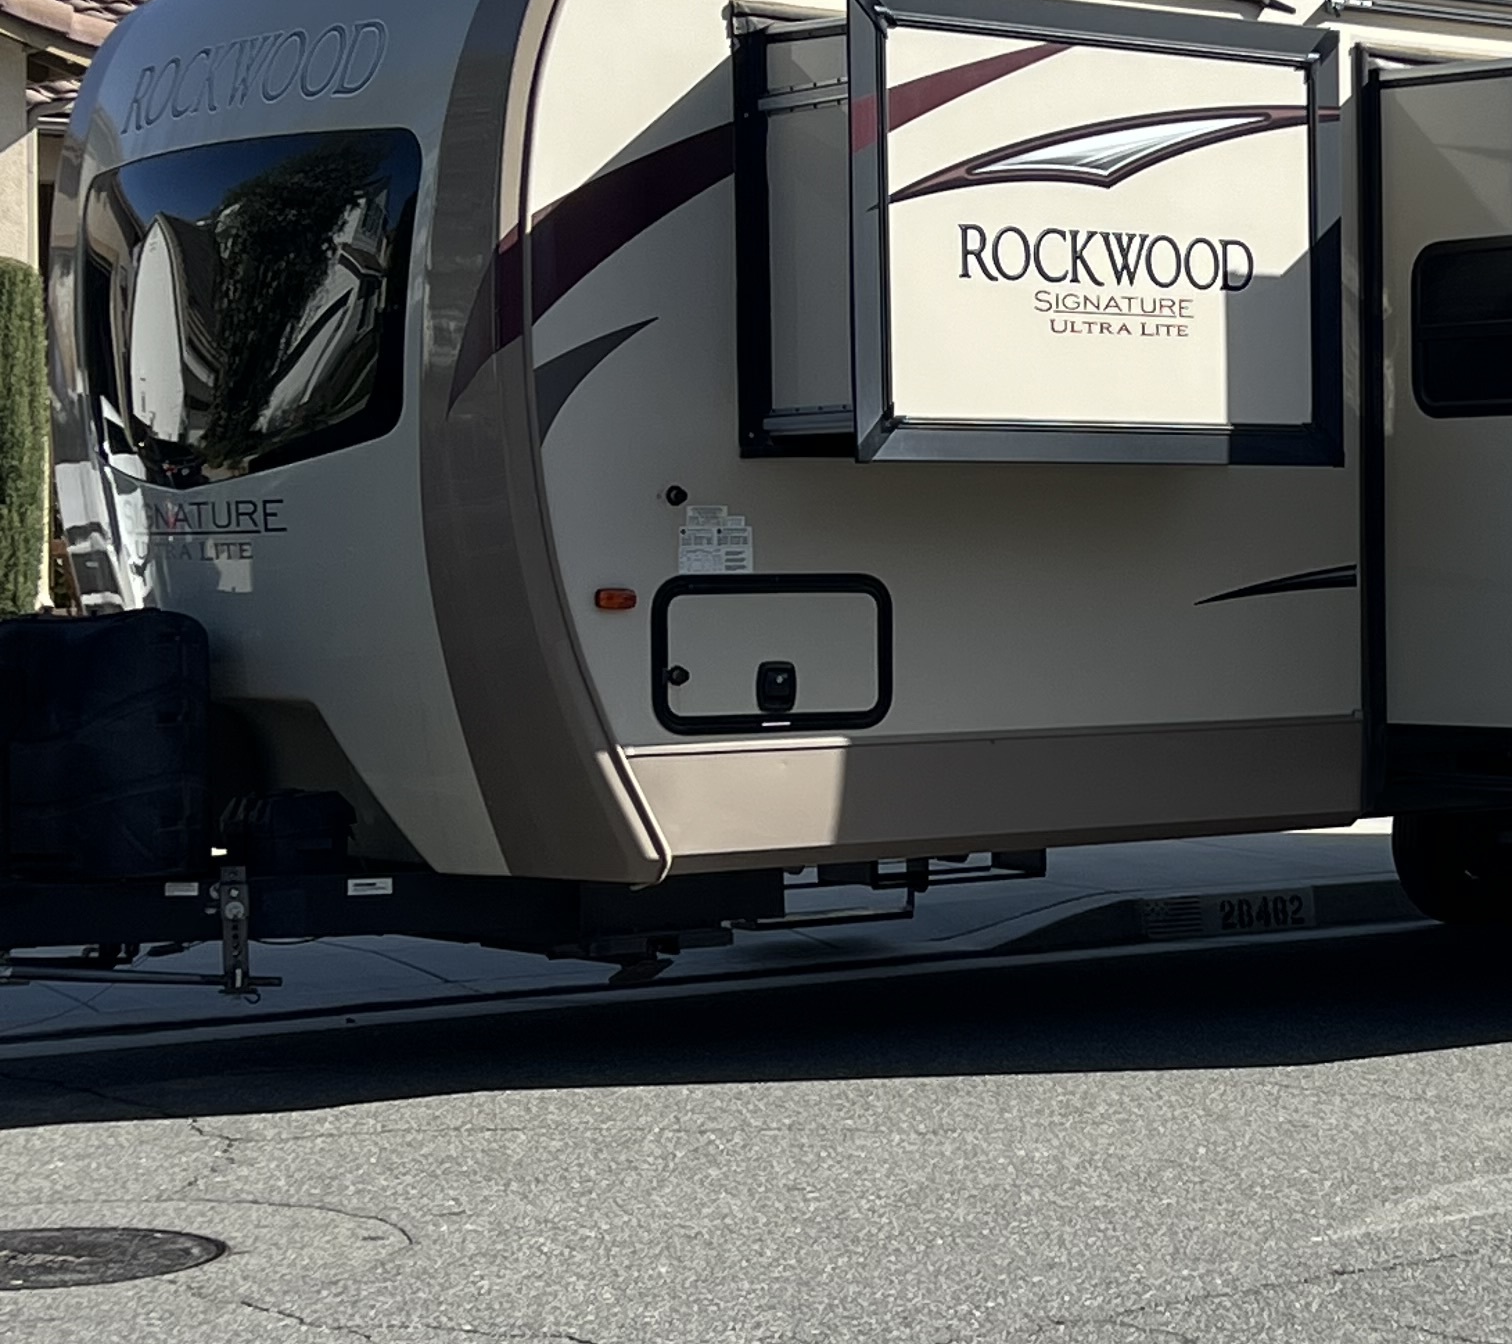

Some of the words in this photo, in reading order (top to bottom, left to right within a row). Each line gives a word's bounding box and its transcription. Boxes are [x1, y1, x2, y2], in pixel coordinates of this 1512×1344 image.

[119, 18, 390, 135] ROCKWOOD
[957, 223, 1254, 292] ROCKWOOD
[1033, 289, 1195, 319] SIGNATURE
[1050, 318, 1133, 336] ULTRA
[1140, 321, 1190, 338] LITE
[199, 541, 254, 562] LITE
